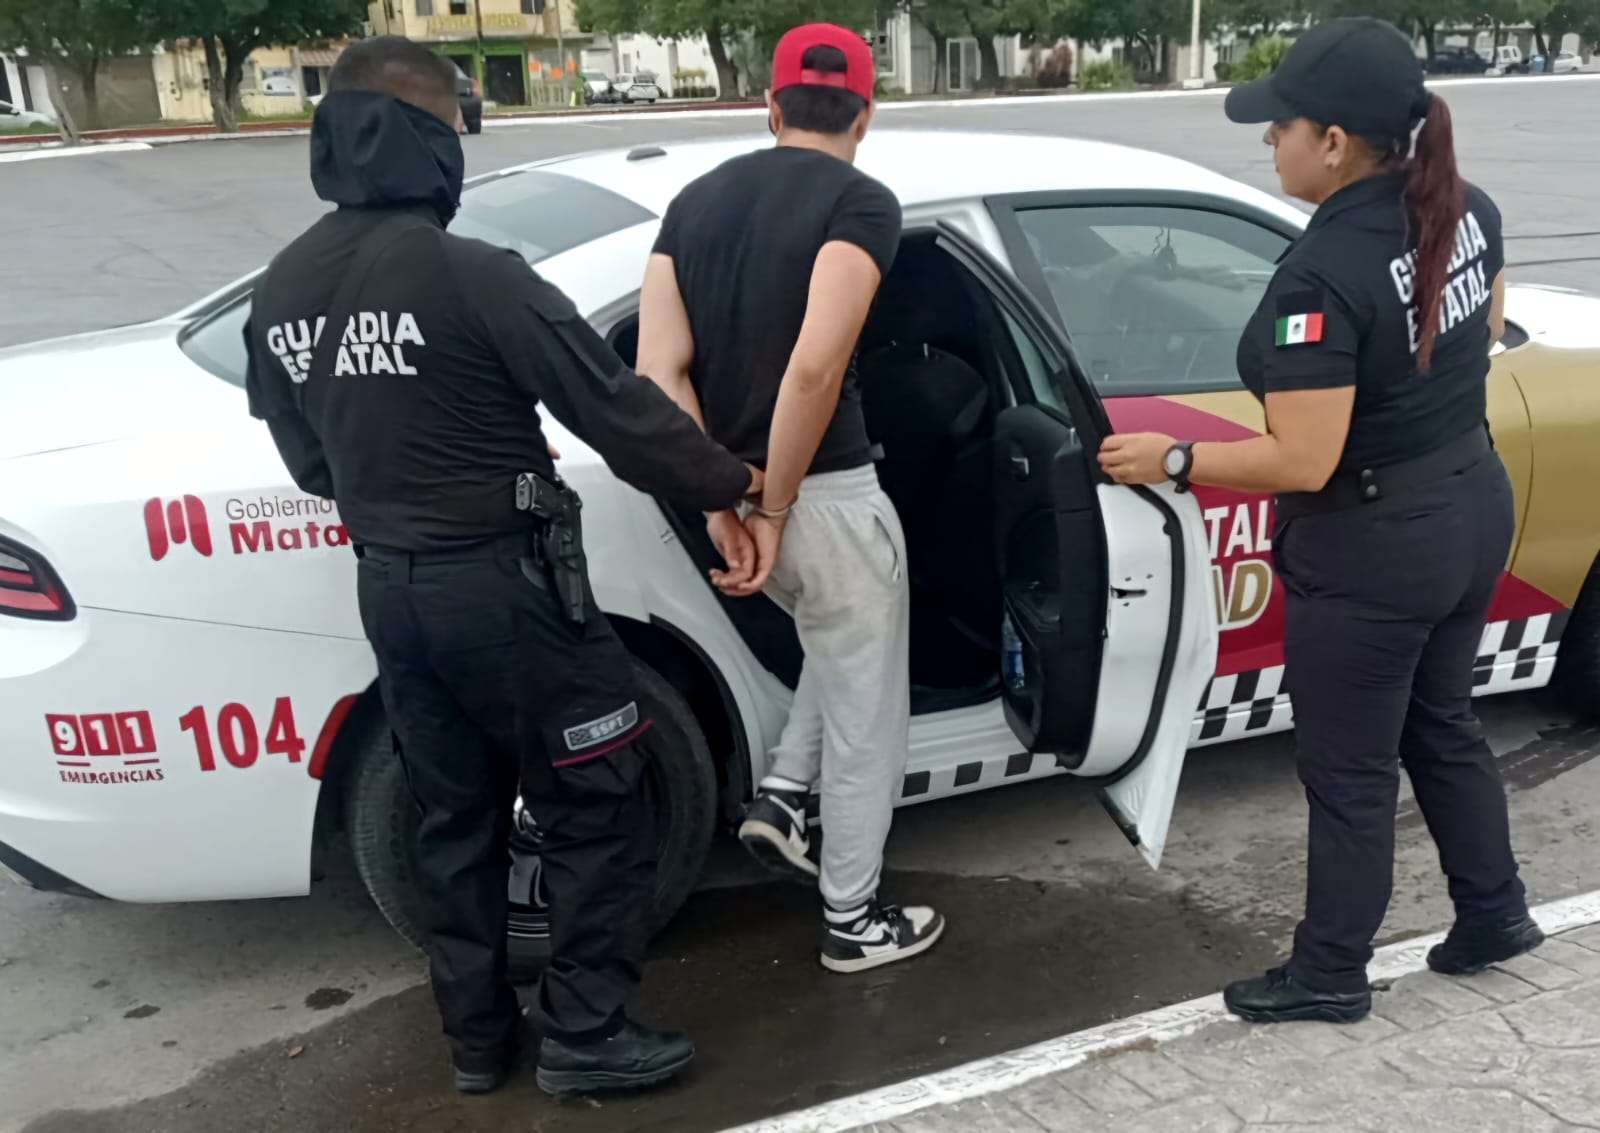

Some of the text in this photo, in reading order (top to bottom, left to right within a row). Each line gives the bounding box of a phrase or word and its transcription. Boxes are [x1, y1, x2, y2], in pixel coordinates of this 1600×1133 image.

[279, 342, 419, 384] ESATAL
[51, 714, 147, 753] 911
[178, 695, 306, 772] 104
